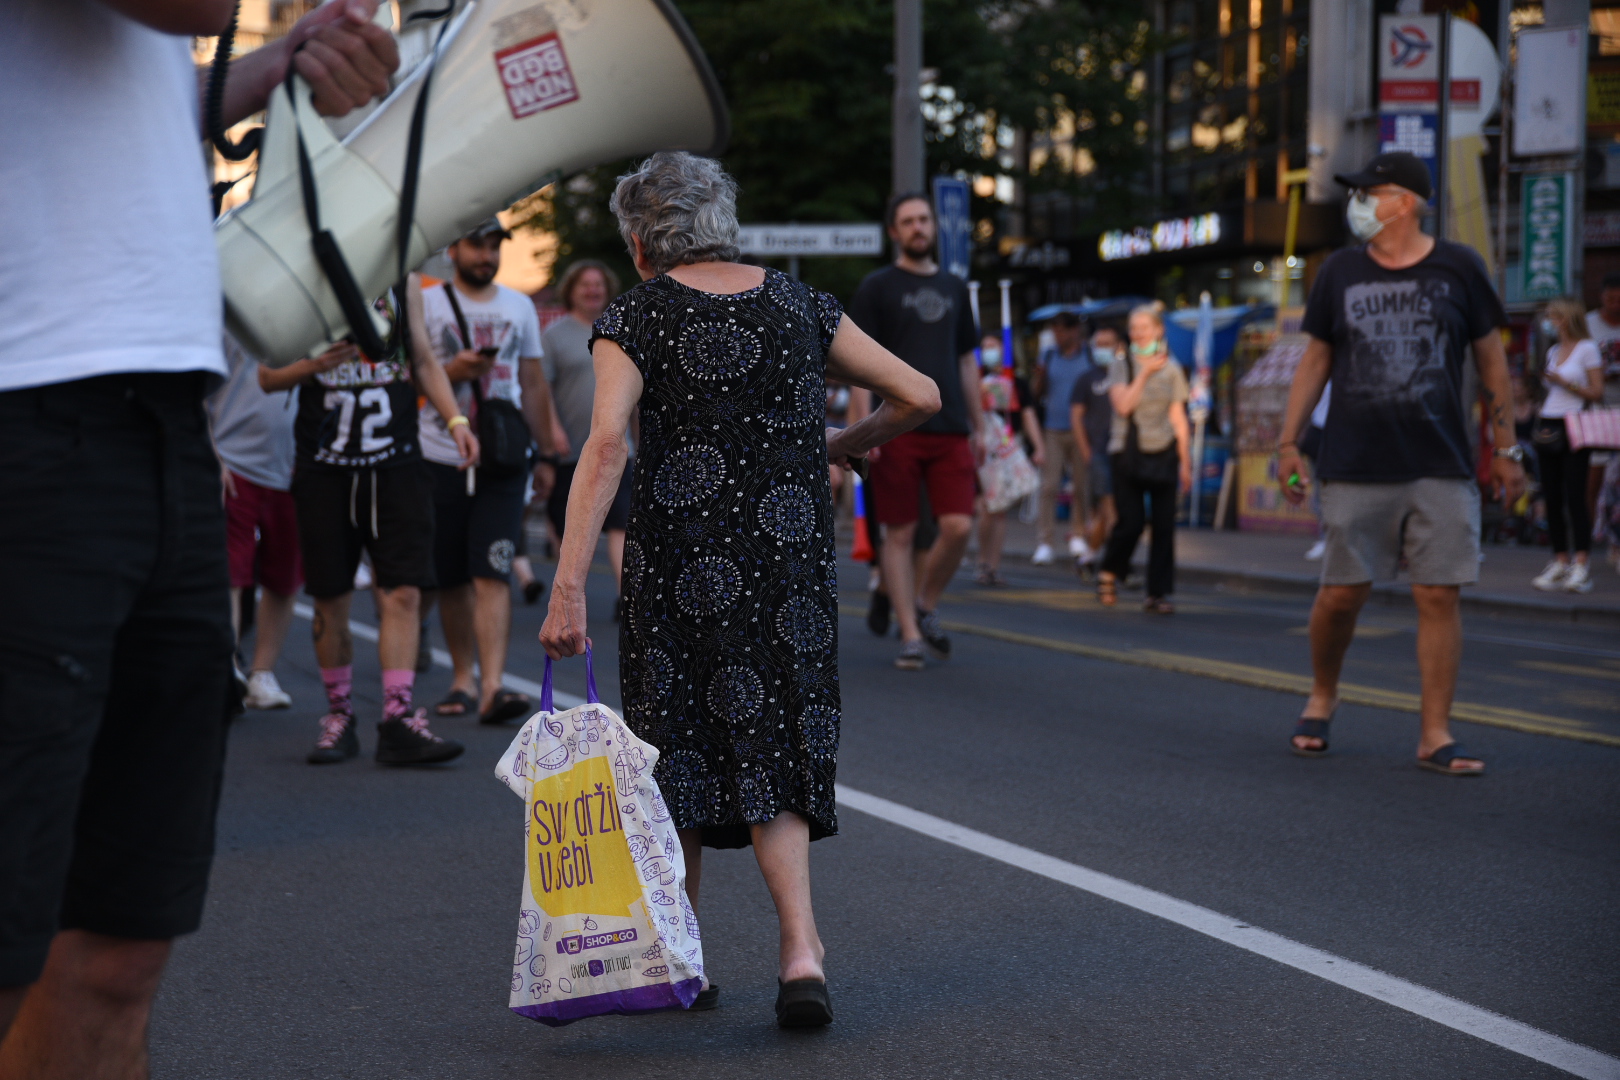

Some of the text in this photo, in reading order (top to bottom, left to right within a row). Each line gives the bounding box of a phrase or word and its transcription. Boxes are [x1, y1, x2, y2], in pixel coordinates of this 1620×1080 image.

[503, 49, 565, 85] BGD
[510, 72, 572, 107] NDM
[324, 387, 395, 453] 72
[586, 930, 635, 947] SHOP&GO
